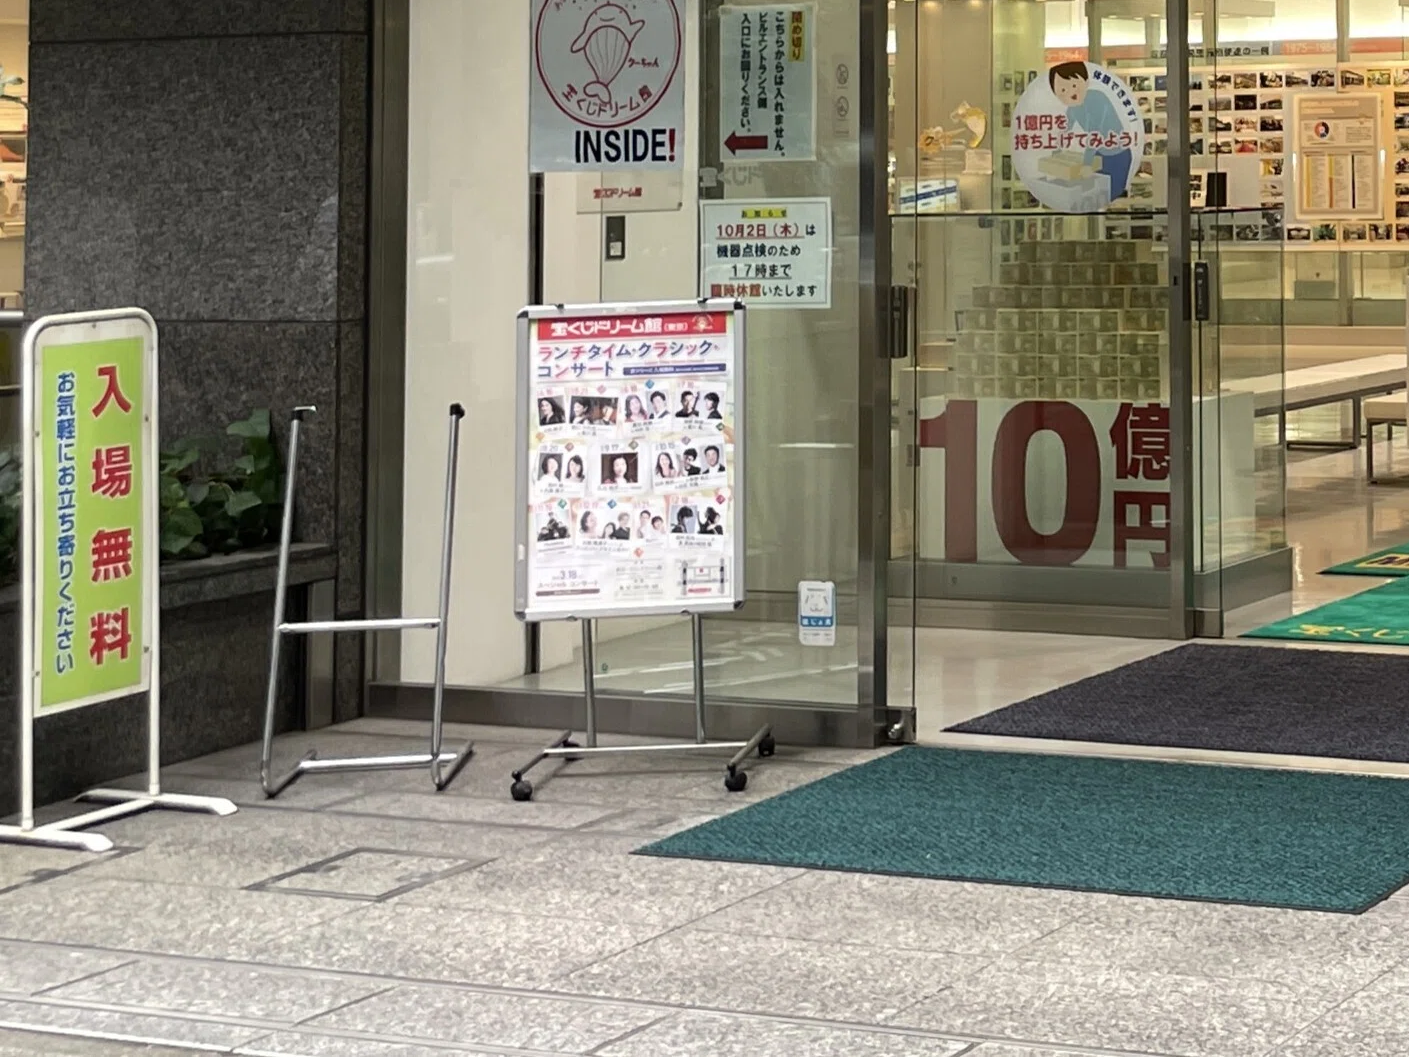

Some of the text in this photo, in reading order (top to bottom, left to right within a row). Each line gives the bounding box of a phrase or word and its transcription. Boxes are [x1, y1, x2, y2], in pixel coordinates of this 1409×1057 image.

[773, 11, 785, 157] こちらからは入れません。
[1015, 114, 1068, 131] 1億円を
[575, 127, 676, 163] INSIDE!
[1014, 131, 1139, 151] 持ち上げてみよう!
[716, 243, 802, 258] 機器点検のため
[538, 361, 614, 379] コンサート
[56, 372, 76, 674] お気軽にお立ち寄りください
[89, 364, 133, 666] 入場無料
